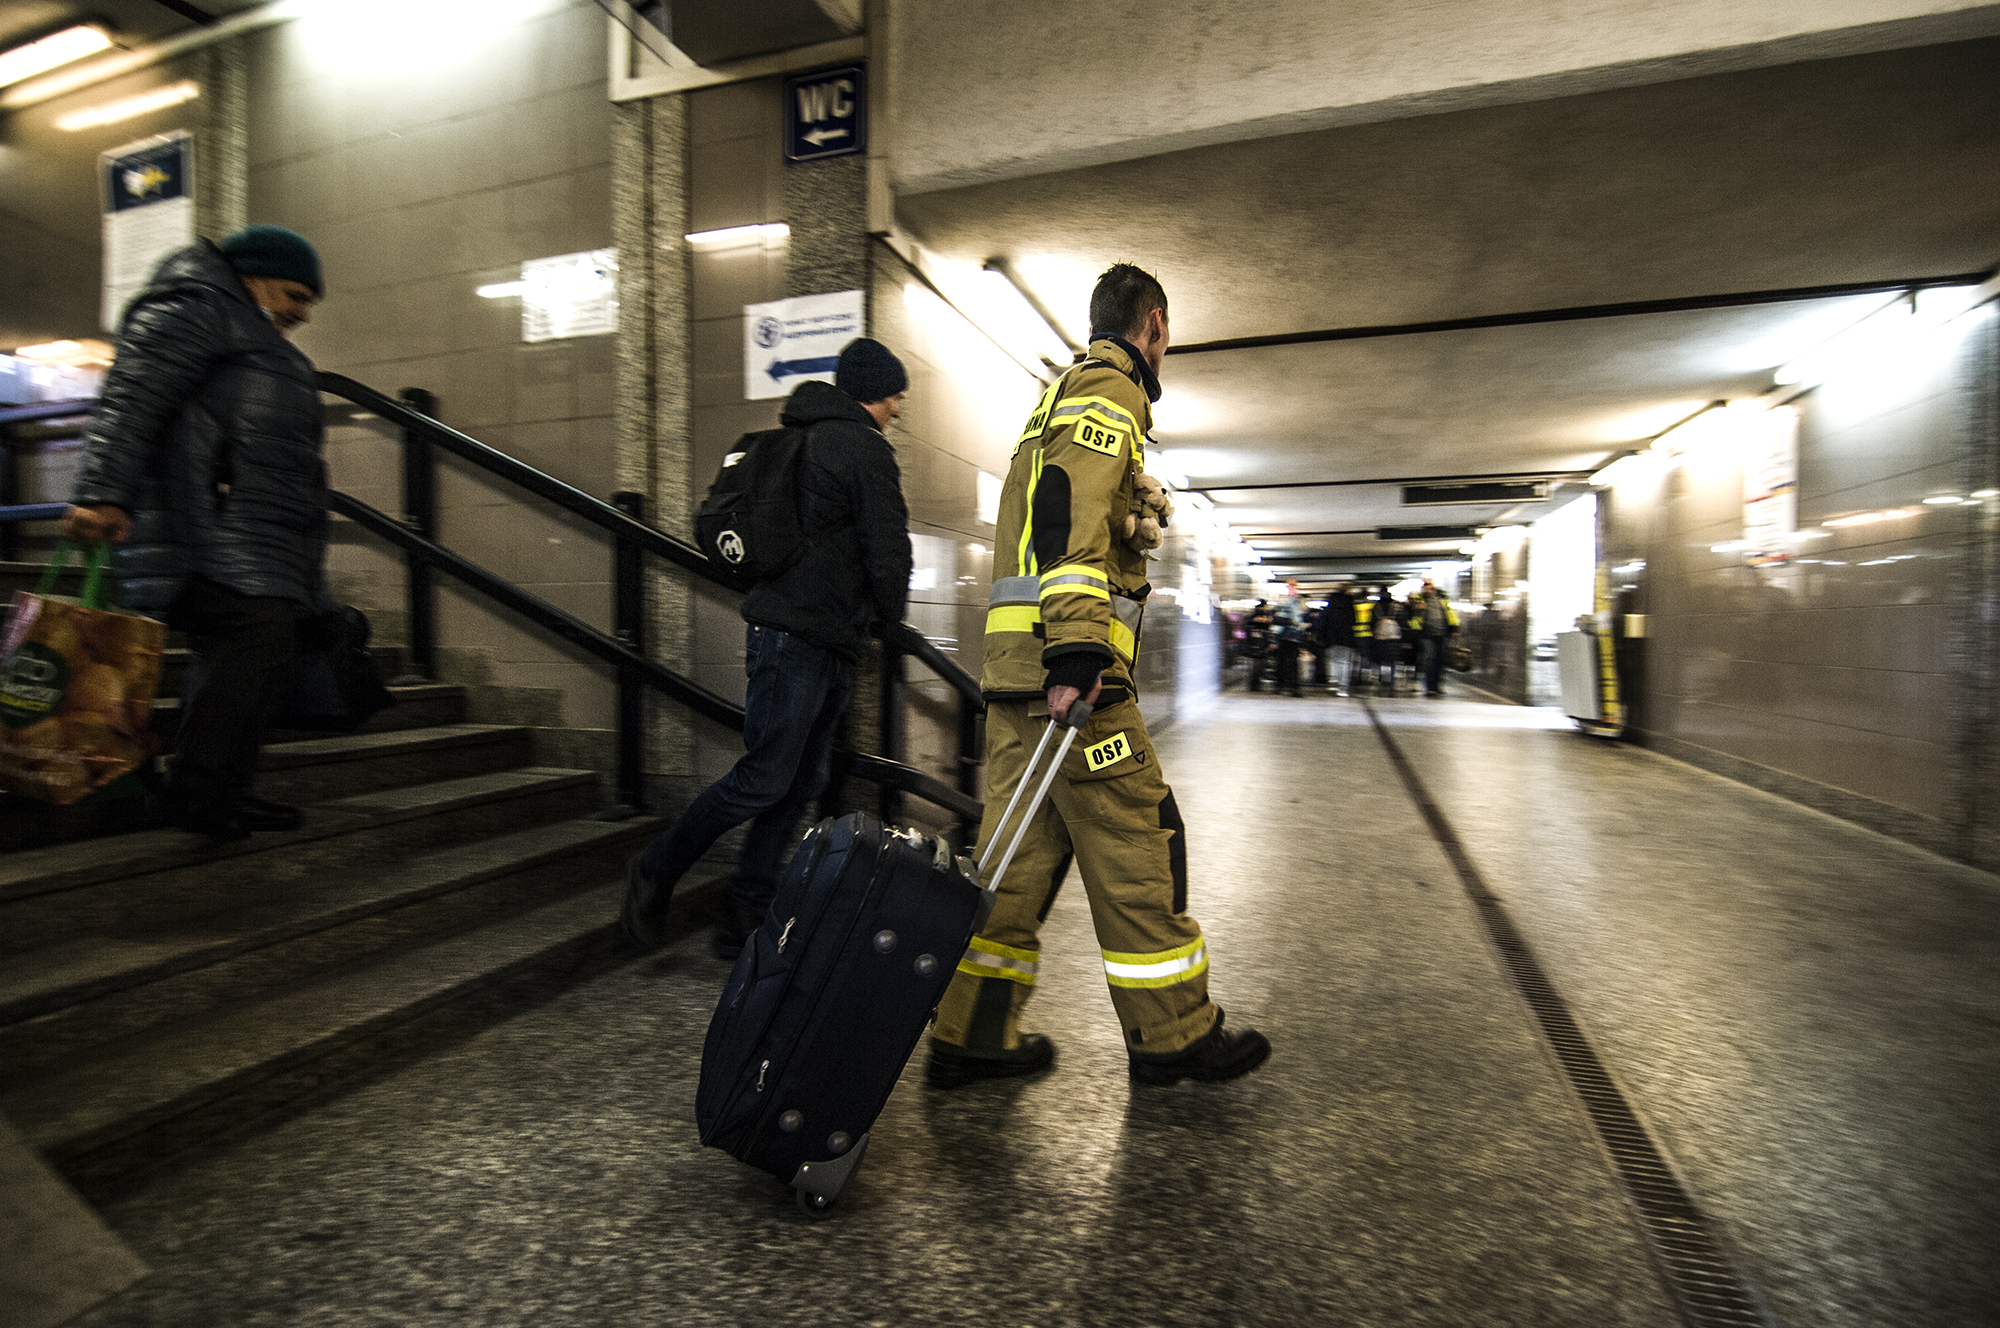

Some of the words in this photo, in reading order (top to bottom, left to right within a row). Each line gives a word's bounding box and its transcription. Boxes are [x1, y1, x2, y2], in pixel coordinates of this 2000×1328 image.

[796, 79, 855, 123] WC
[1082, 425, 1116, 449] OSP
[1092, 738, 1123, 765] OSP
